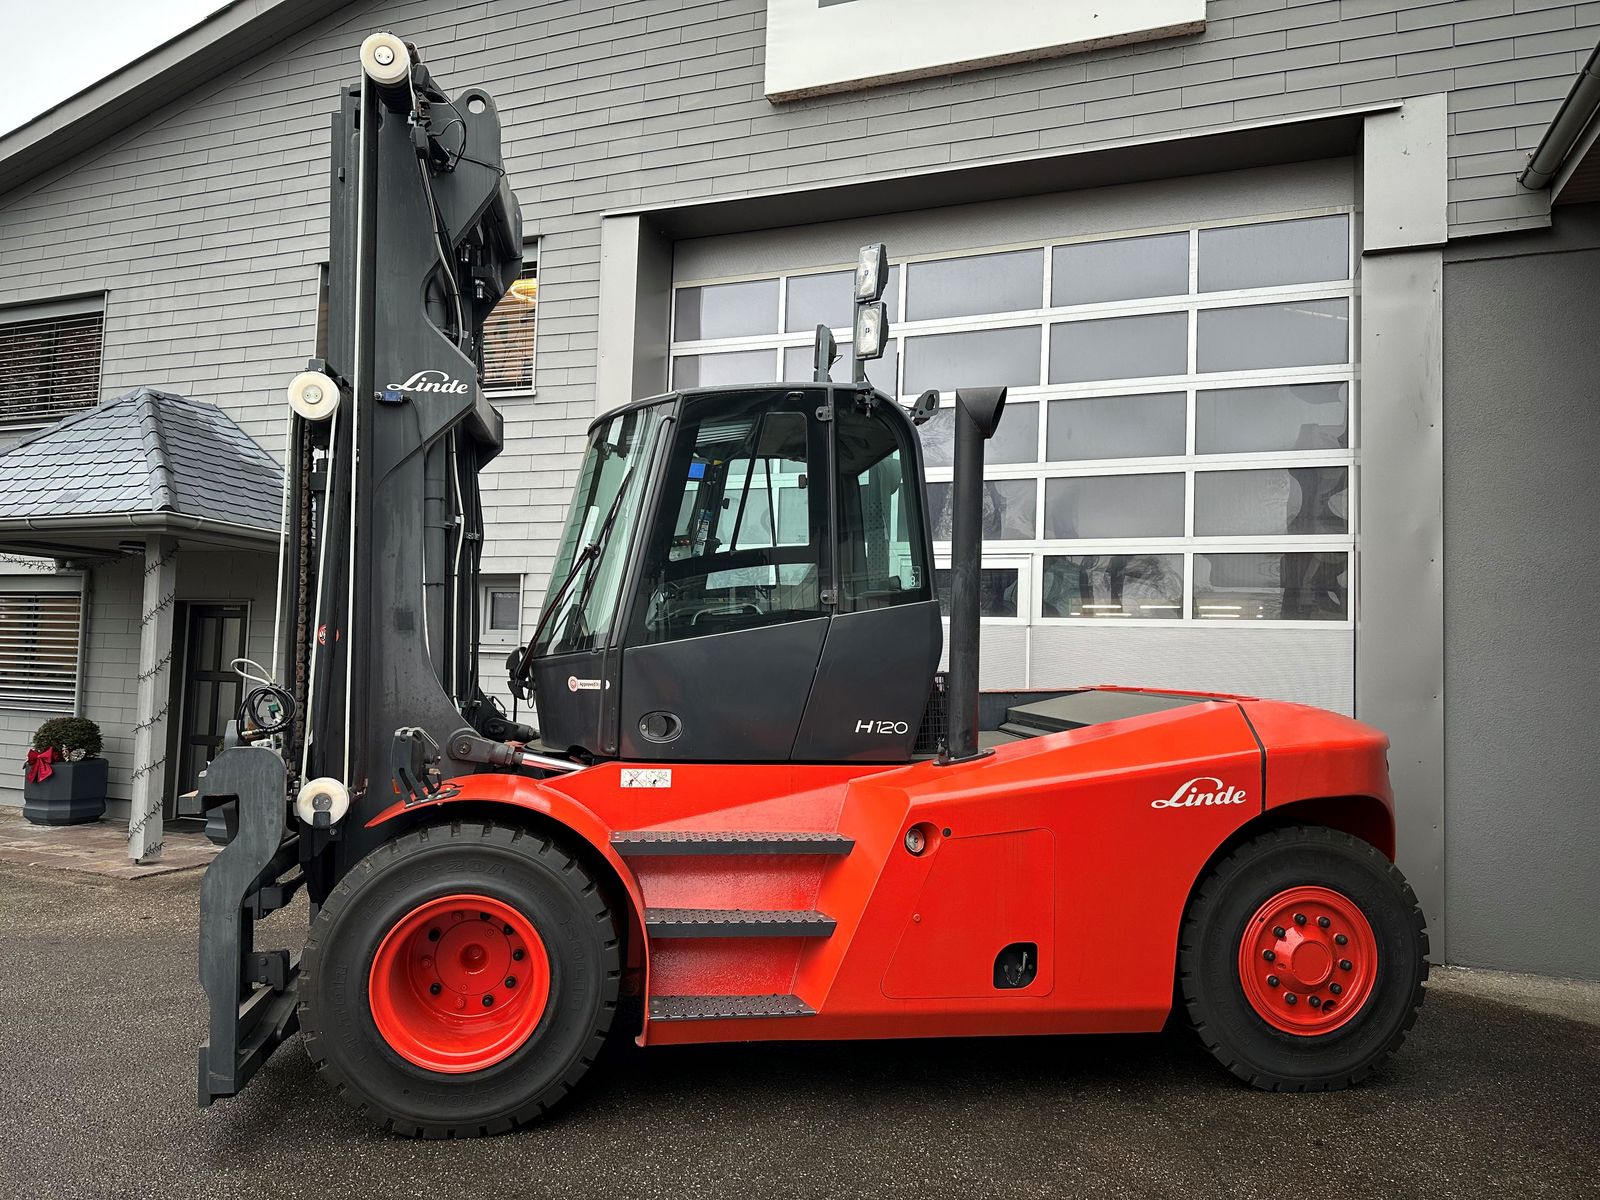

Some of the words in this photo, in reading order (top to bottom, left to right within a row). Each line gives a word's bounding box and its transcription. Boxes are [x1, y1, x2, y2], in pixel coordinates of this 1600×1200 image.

[386, 370, 468, 394] Linde
[855, 719, 908, 734] H120
[1151, 777, 1246, 808] Linde
